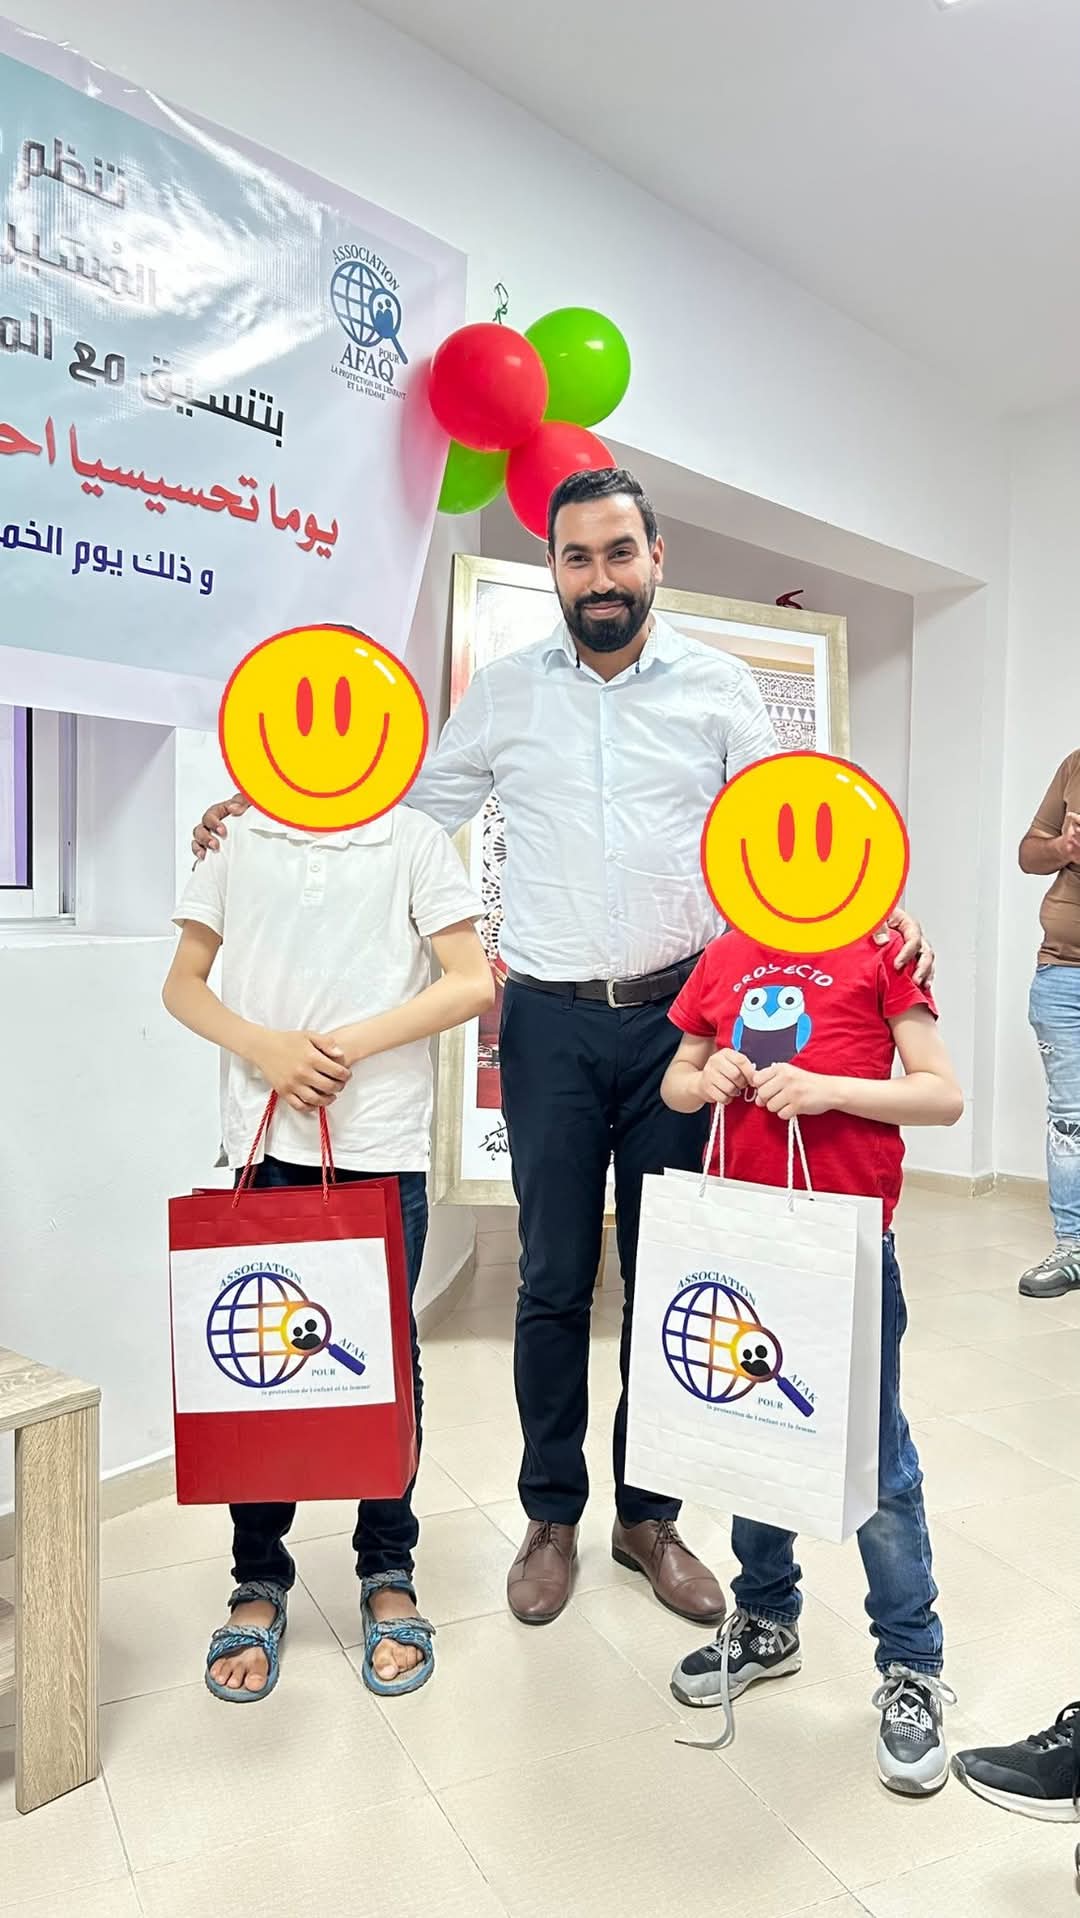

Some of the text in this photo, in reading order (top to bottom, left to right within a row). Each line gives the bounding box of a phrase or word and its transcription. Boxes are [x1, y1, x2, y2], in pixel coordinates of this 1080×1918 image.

[18, 137, 126, 209] تنظم
[332, 244, 400, 291] ASSOCIATION
[69, 341, 125, 387] مع
[340, 343, 394, 387] AFAQ
[378, 347, 400, 364] POUR
[339, 368, 374, 388] PROTECTION
[347, 380, 355, 390] ET
[140, 355, 285, 448] بتنسيق
[69, 422, 259, 523] تحسيسيا
[269, 482, 339, 560] يوما
[71, 541, 123, 577] يوم
[132, 550, 193, 584] ذلك
[199, 568, 214, 595] و
[732, 963, 834, 993] PROYECTO
[219, 1261, 303, 1291] ASSOCIATION
[677, 1271, 757, 1306] ASSOCIATION
[311, 1367, 337, 1378] POUR
[757, 1396, 784, 1410] POUR
